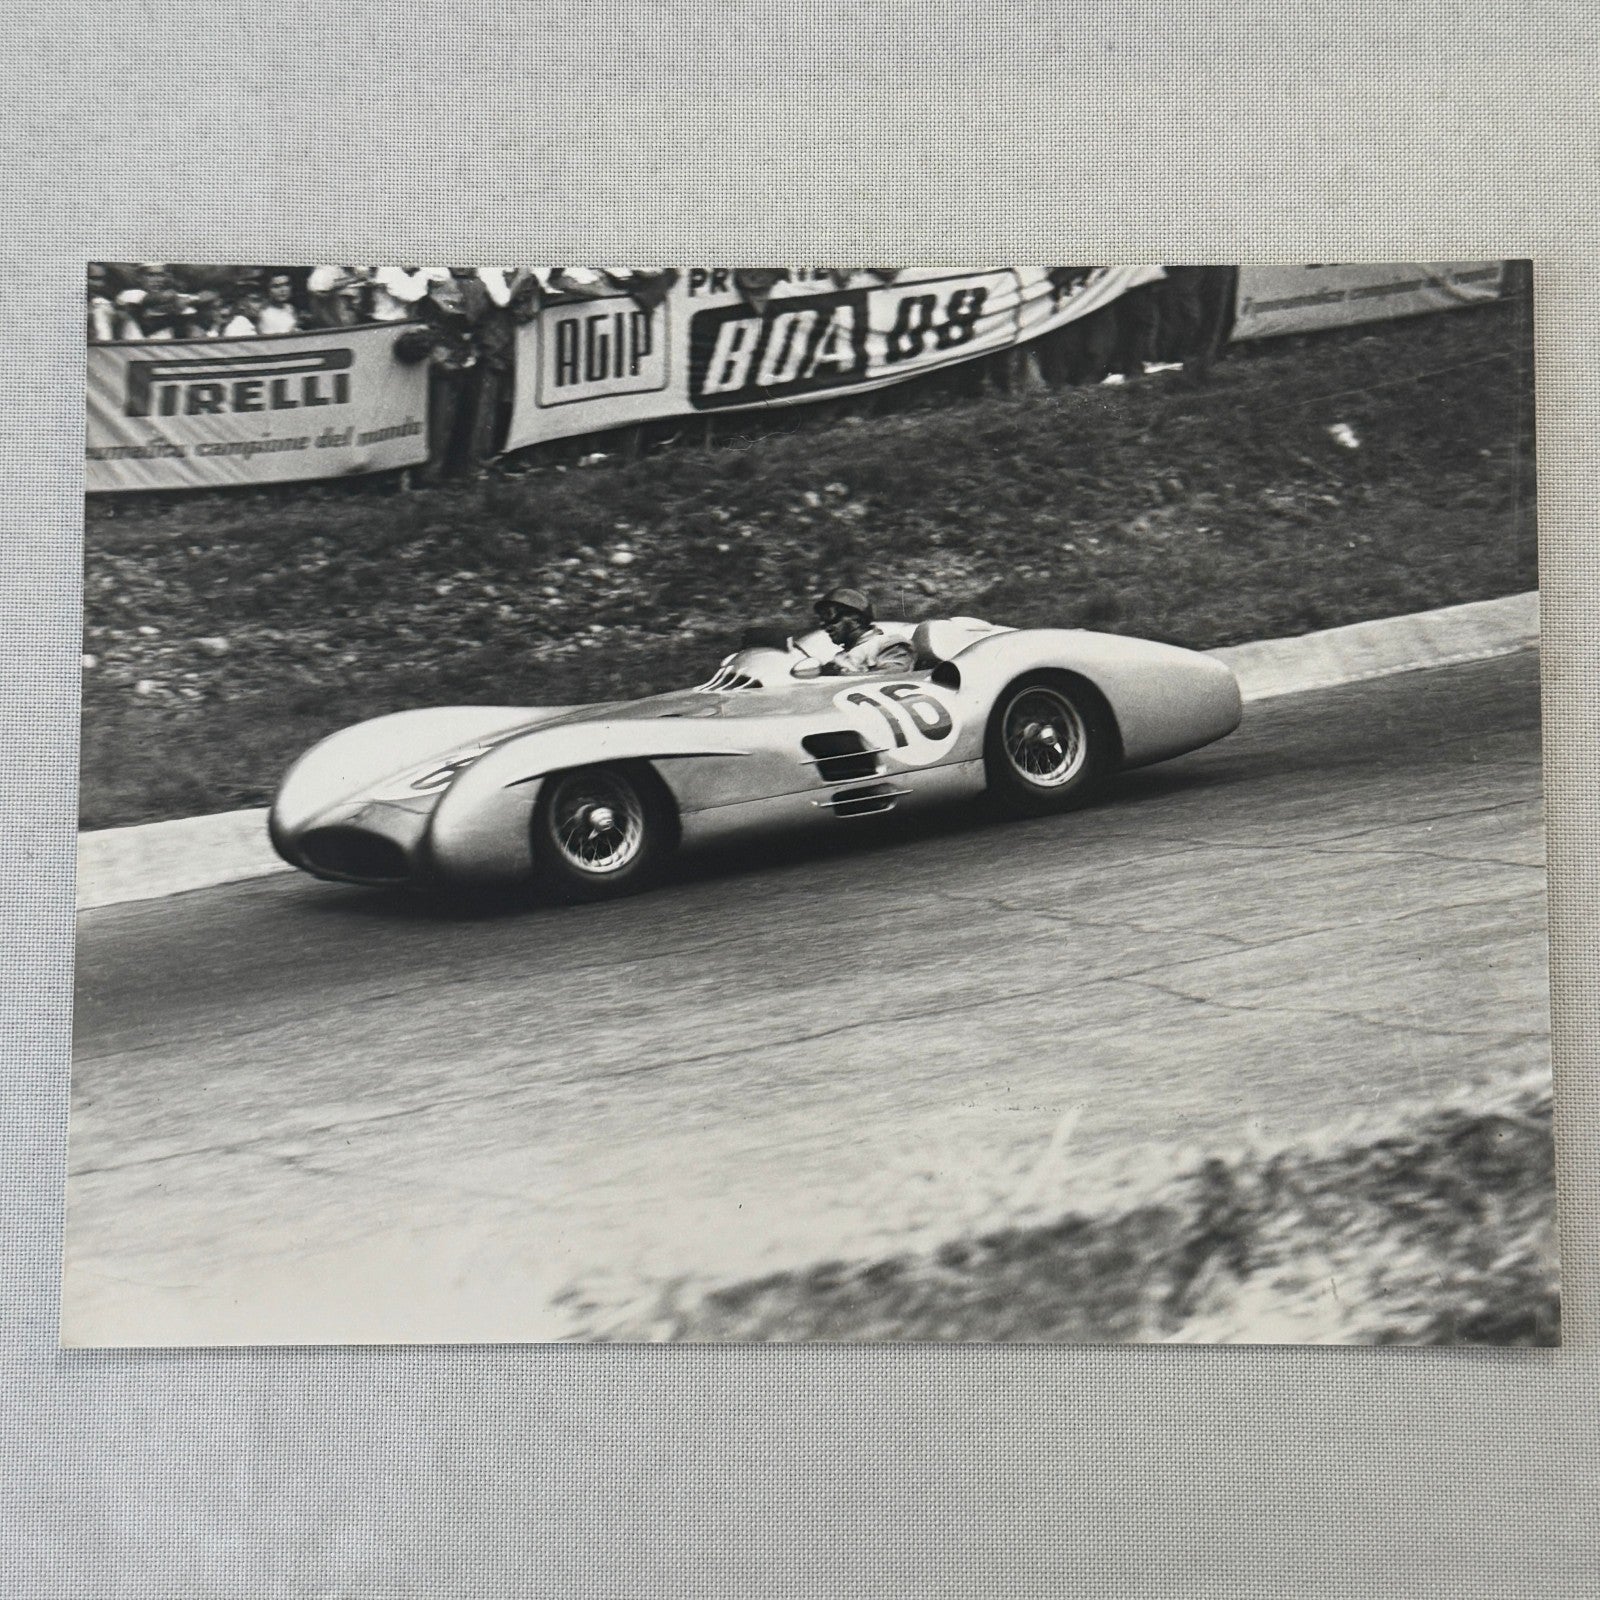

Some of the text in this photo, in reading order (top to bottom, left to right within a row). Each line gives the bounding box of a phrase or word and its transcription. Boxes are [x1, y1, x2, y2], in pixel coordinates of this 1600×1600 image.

[125, 348, 354, 418] PIRELLI
[554, 310, 651, 388] AGIP
[846, 683, 953, 748] 16
